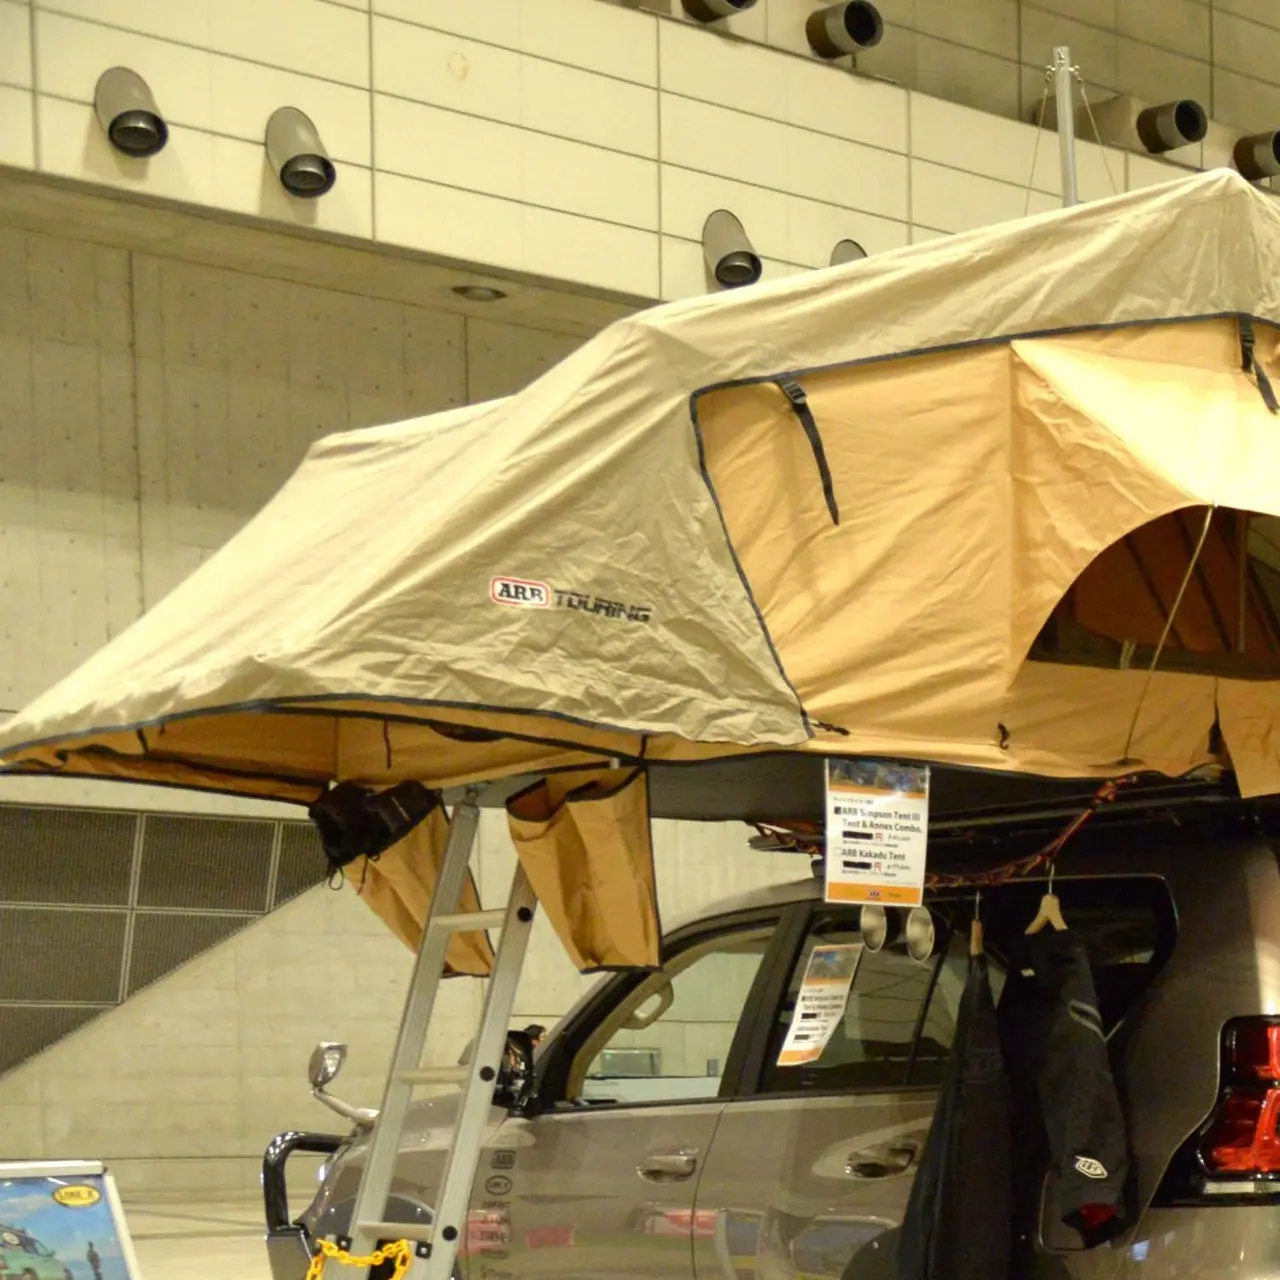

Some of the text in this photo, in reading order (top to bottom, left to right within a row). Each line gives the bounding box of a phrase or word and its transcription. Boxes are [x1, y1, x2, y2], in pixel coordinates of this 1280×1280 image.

[497, 582, 653, 624] ARB TOURING
[859, 848, 888, 860] Kakadu
[889, 851, 906, 861] Tent
